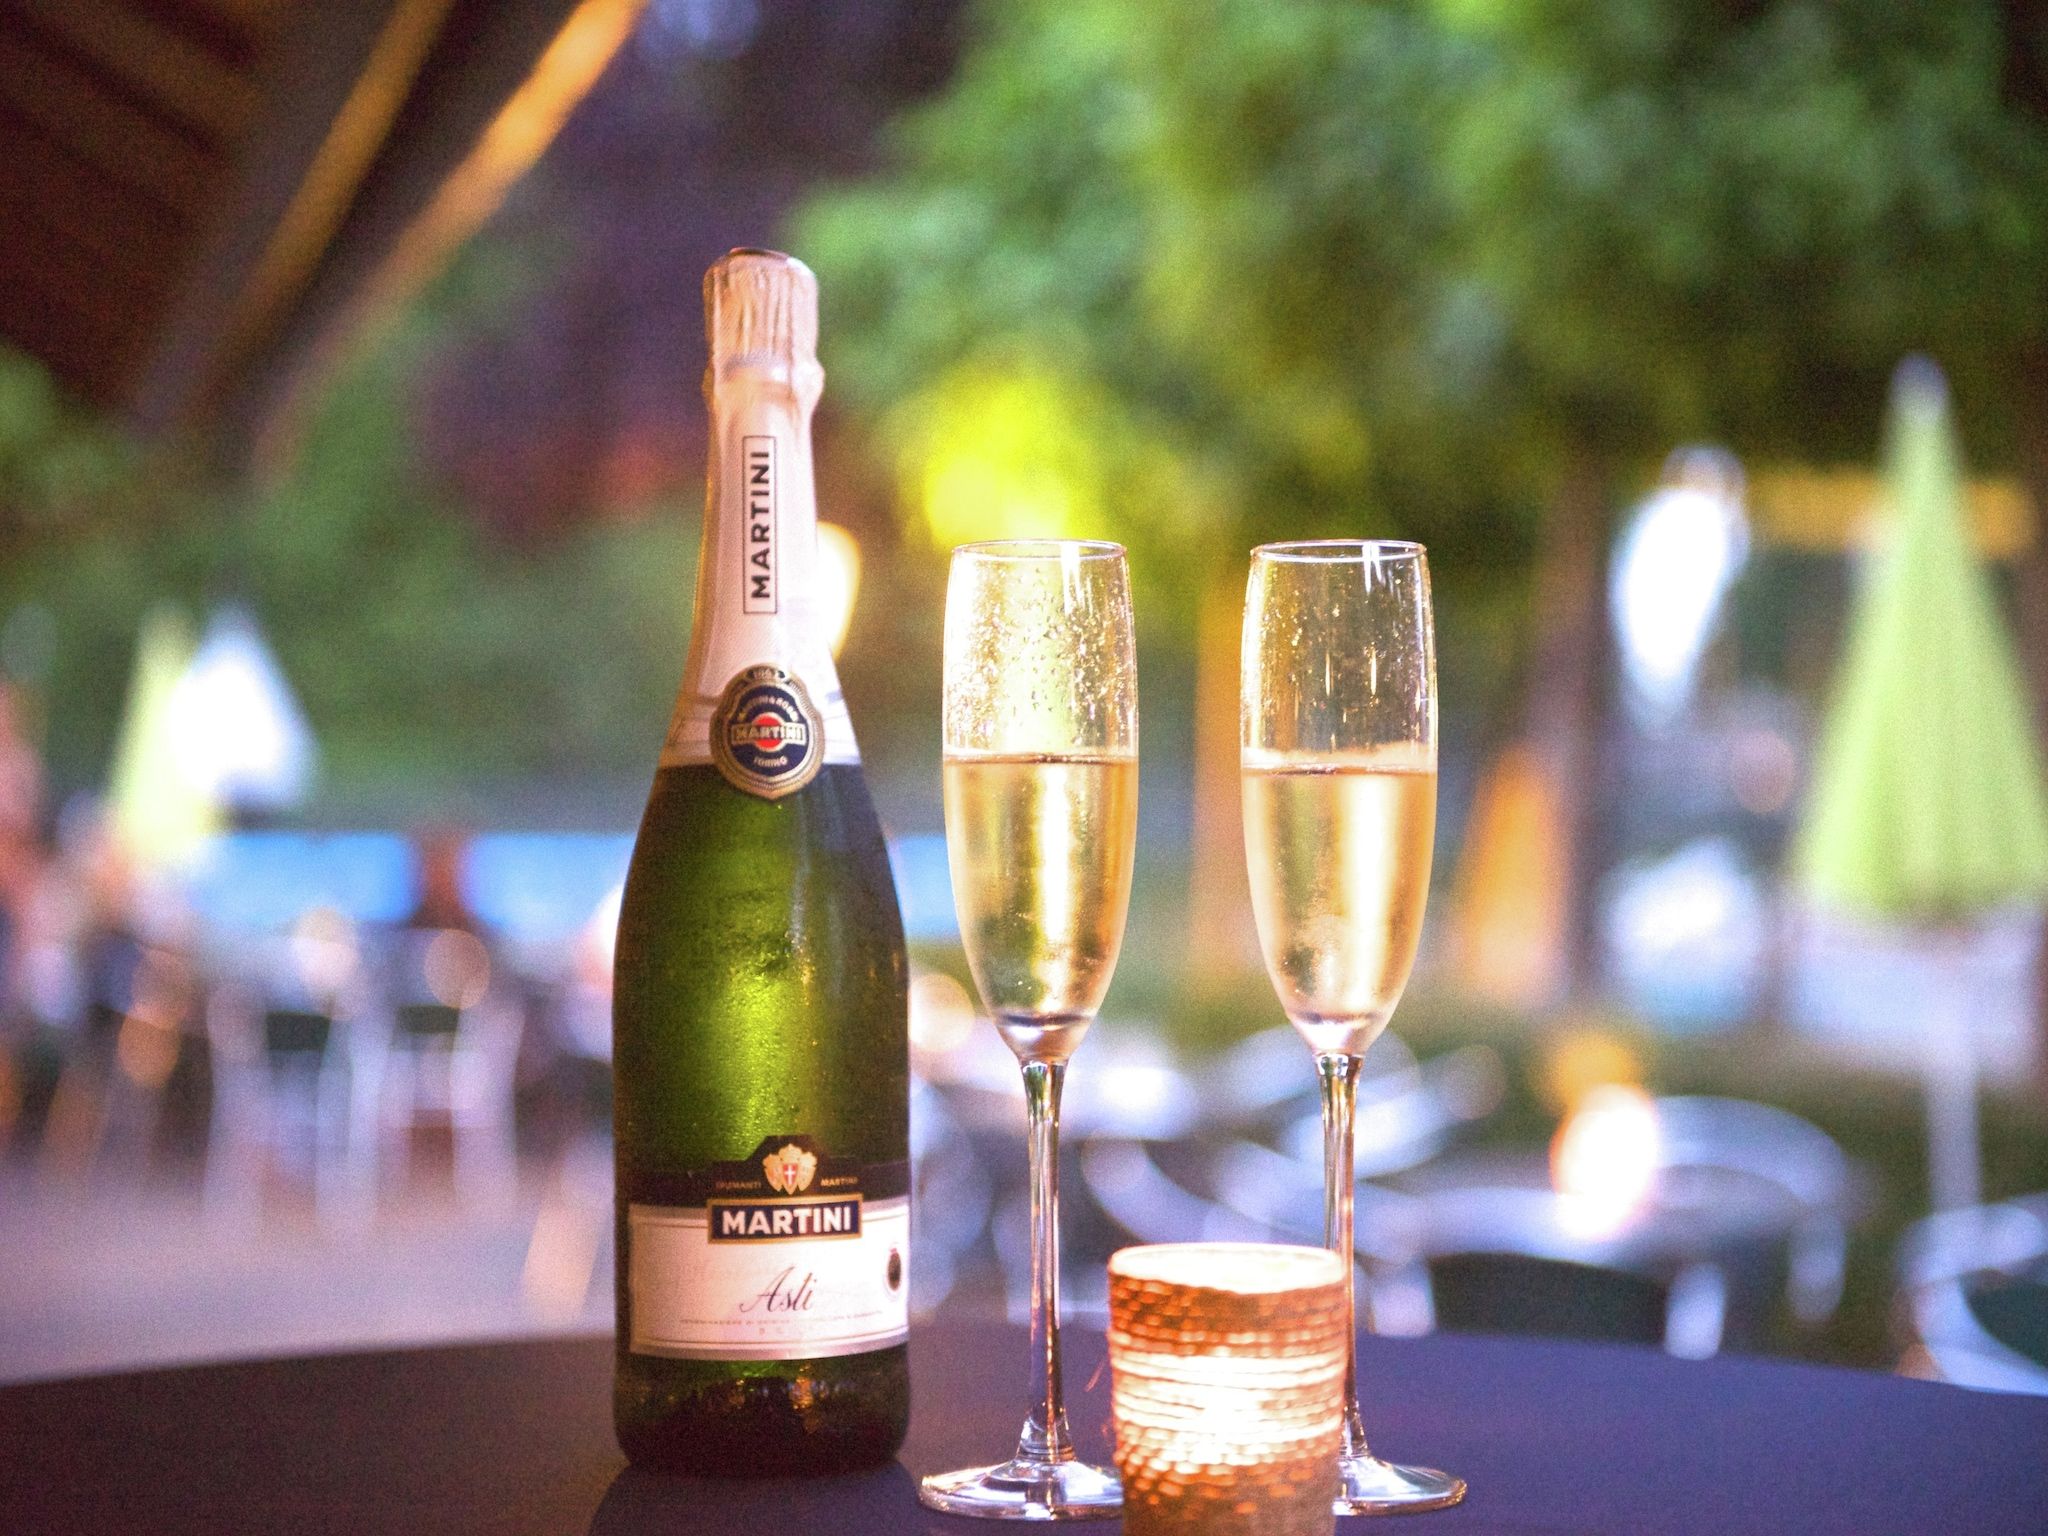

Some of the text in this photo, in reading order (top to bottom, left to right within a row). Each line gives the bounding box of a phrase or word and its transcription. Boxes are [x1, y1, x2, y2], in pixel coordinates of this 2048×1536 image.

[750, 451, 770, 599] MARTINI
[722, 1206, 852, 1234] MARTINI
[739, 1265, 817, 1312] Asti
